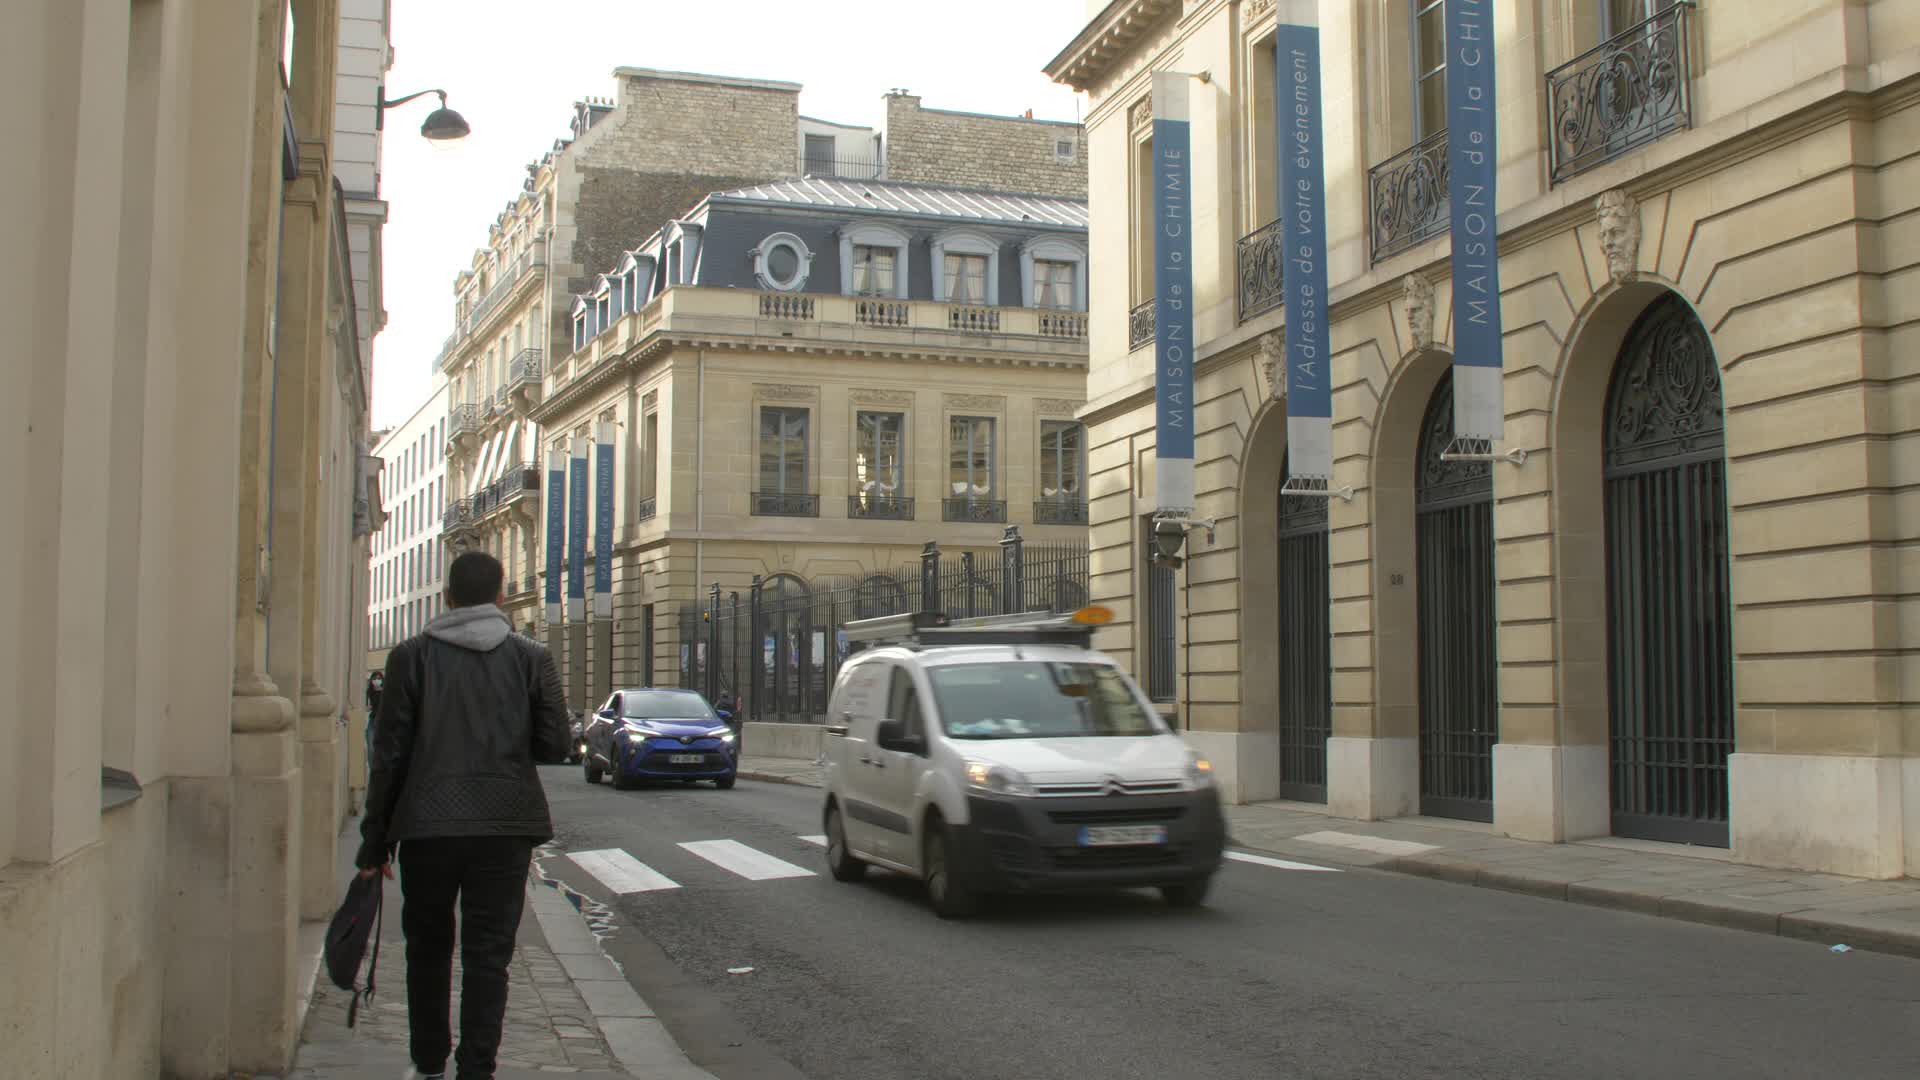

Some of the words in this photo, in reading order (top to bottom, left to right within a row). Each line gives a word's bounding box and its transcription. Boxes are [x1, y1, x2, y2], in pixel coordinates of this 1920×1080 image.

[1458, 0, 1481, 67] CHI
[1459, 87, 1482, 111] la
[1461, 130, 1484, 165] de
[1165, 150, 1182, 237] CHIMIE
[1296, 179, 1313, 235] votre
[1165, 251, 1182, 271] la
[1292, 245, 1313, 273] de
[1463, 184, 1489, 325] MAISON
[1166, 284, 1183, 311] de
[1296, 286, 1317, 390] l'Adresse
[1167, 324, 1184, 427] MAISON
